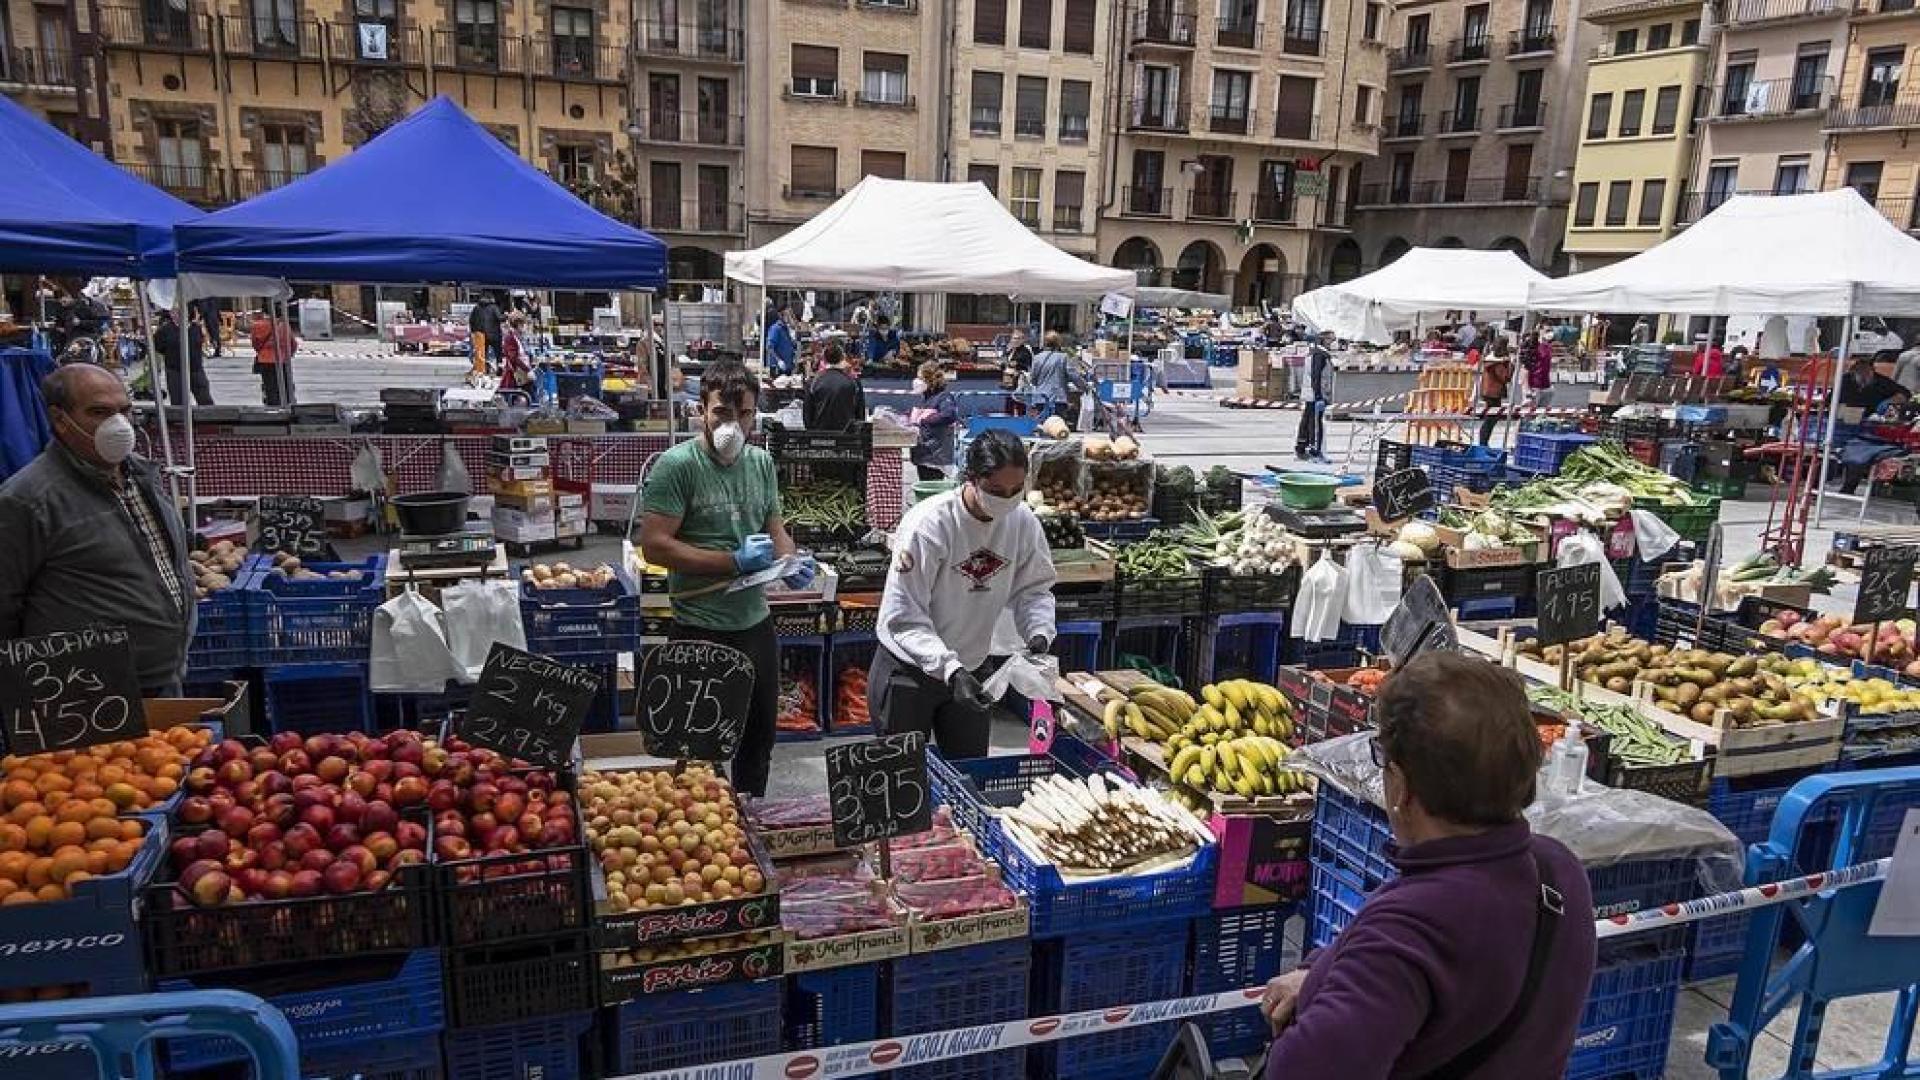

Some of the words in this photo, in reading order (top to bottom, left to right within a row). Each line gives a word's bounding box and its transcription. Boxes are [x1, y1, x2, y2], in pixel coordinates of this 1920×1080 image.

[26, 661, 63, 703] 3
[487, 675, 519, 703] 2
[15, 695, 129, 750] 4'50
[831, 769, 924, 824] 3'95
